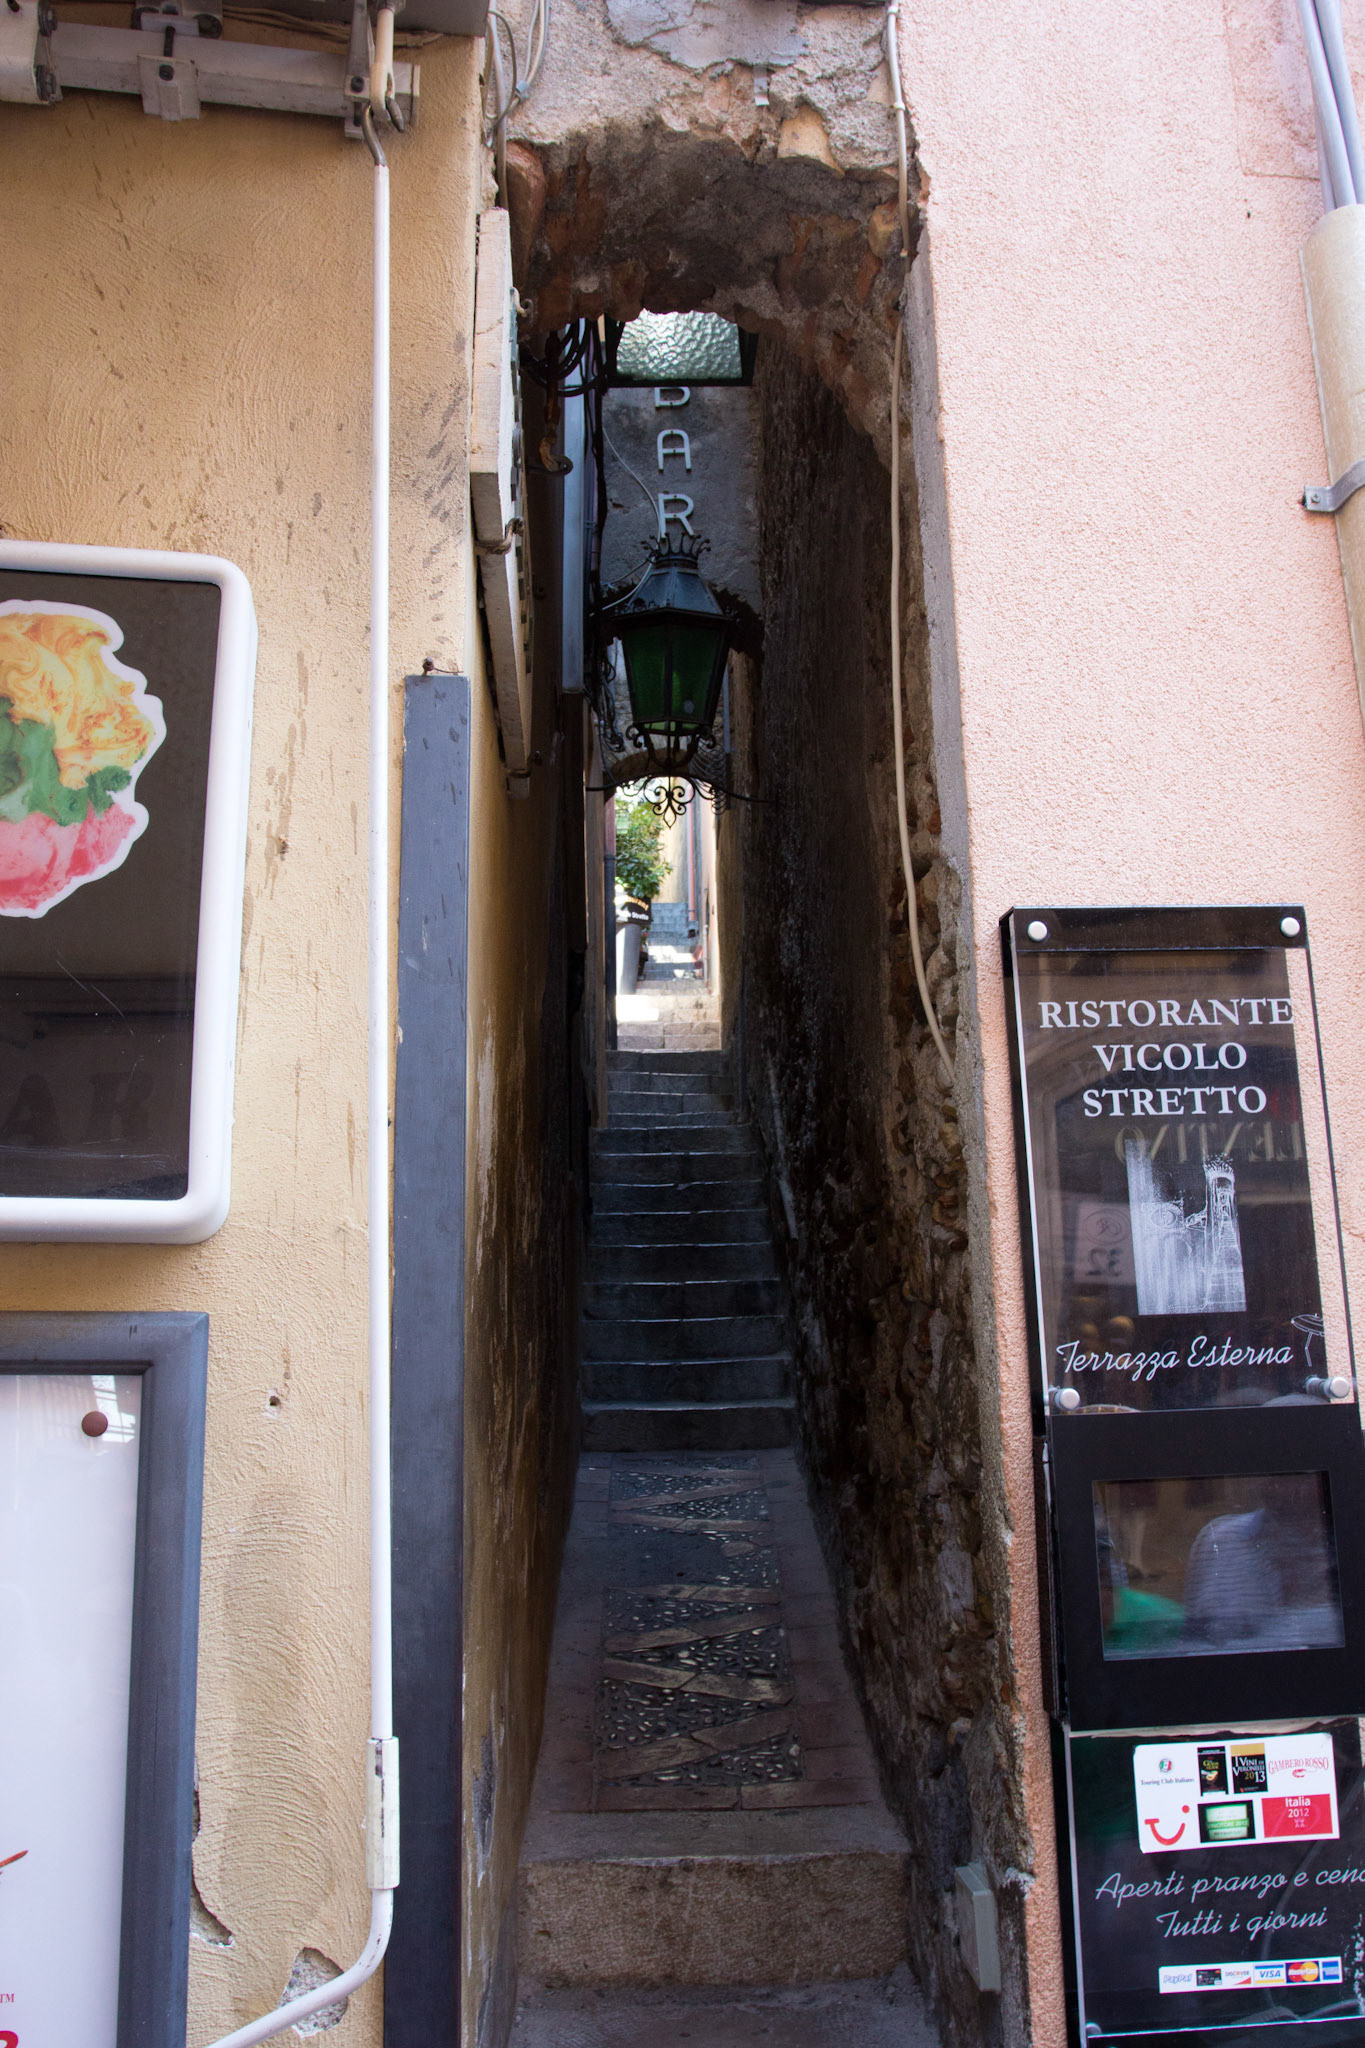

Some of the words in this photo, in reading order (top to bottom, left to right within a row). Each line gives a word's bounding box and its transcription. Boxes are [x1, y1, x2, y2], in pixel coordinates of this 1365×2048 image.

[1038, 998, 1294, 1028] RISTORANTE
[1092, 1042, 1247, 1072] VICOLO
[1082, 1086, 1267, 1117] STRETTO
[1056, 1340, 1180, 1381] Terrazza
[1187, 1336, 1293, 1367] Esterna
[1244, 1771, 1265, 1783] 2013
[1268, 1759, 1304, 1774] GAMBERO
[1305, 1757, 1329, 1771] ROSSO
[1285, 1796, 1311, 1807] Italia
[1288, 1808, 1309, 1818] 2012
[1096, 1870, 1185, 1908] Aperti
[1191, 1873, 1288, 1903] pranzo
[1293, 1872, 1309, 1887] e
[1156, 1909, 1222, 1938] Tutti
[1229, 1913, 1240, 1933] i
[1246, 1906, 1328, 1941] giorni
[1163, 1974, 1192, 1984] PayPal
[1260, 1970, 1281, 1978] VISA
